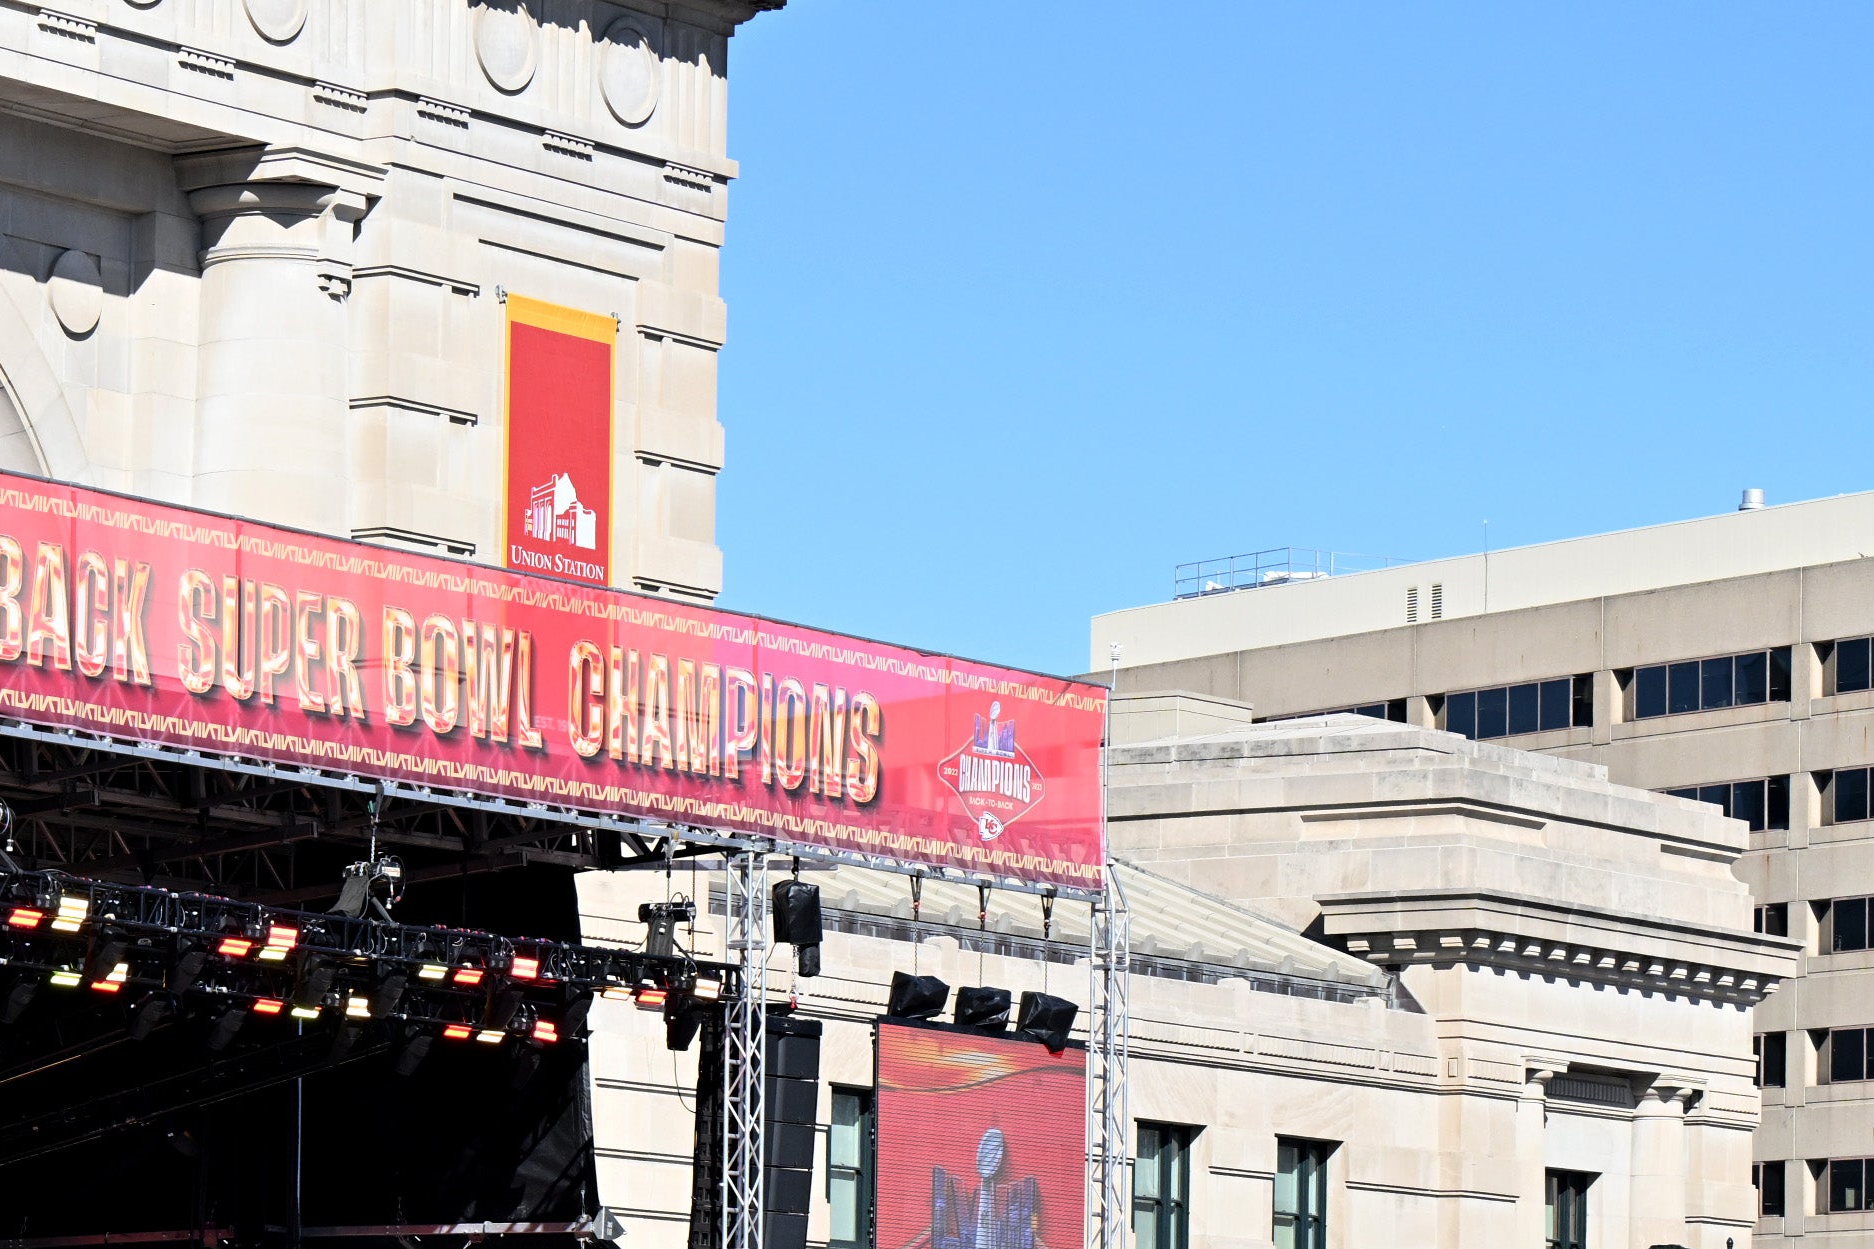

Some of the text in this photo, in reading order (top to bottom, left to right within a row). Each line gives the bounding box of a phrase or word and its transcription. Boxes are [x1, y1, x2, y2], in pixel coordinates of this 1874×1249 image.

[177, 568, 365, 719] SUPER
[382, 605, 542, 748] BOWL
[569, 639, 880, 803] CHAMPIONS
[959, 754, 1031, 803] CHAMPIONS
